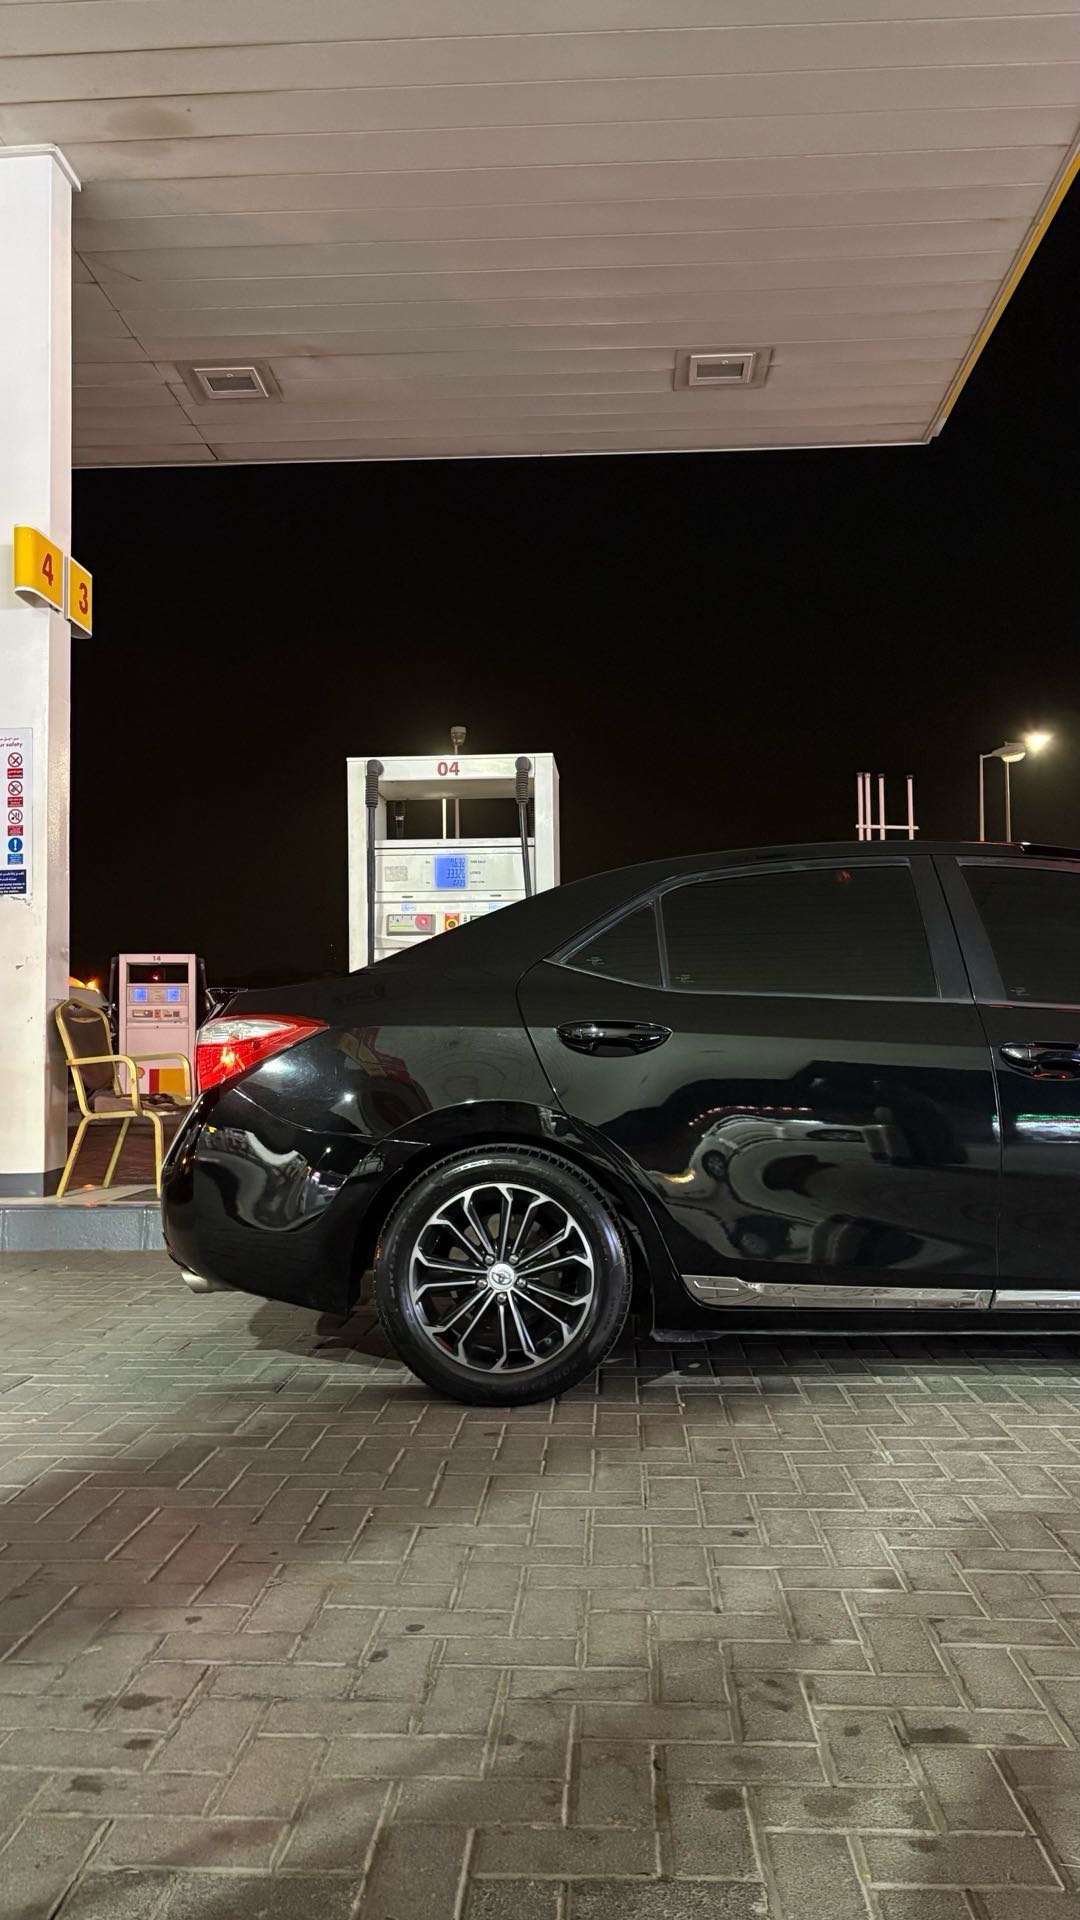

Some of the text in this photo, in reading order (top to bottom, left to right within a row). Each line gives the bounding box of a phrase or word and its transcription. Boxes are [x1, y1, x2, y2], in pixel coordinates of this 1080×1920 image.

[42, 552, 54, 587] 4
[78, 582, 89, 615] 3
[436, 761, 460, 777] 04
